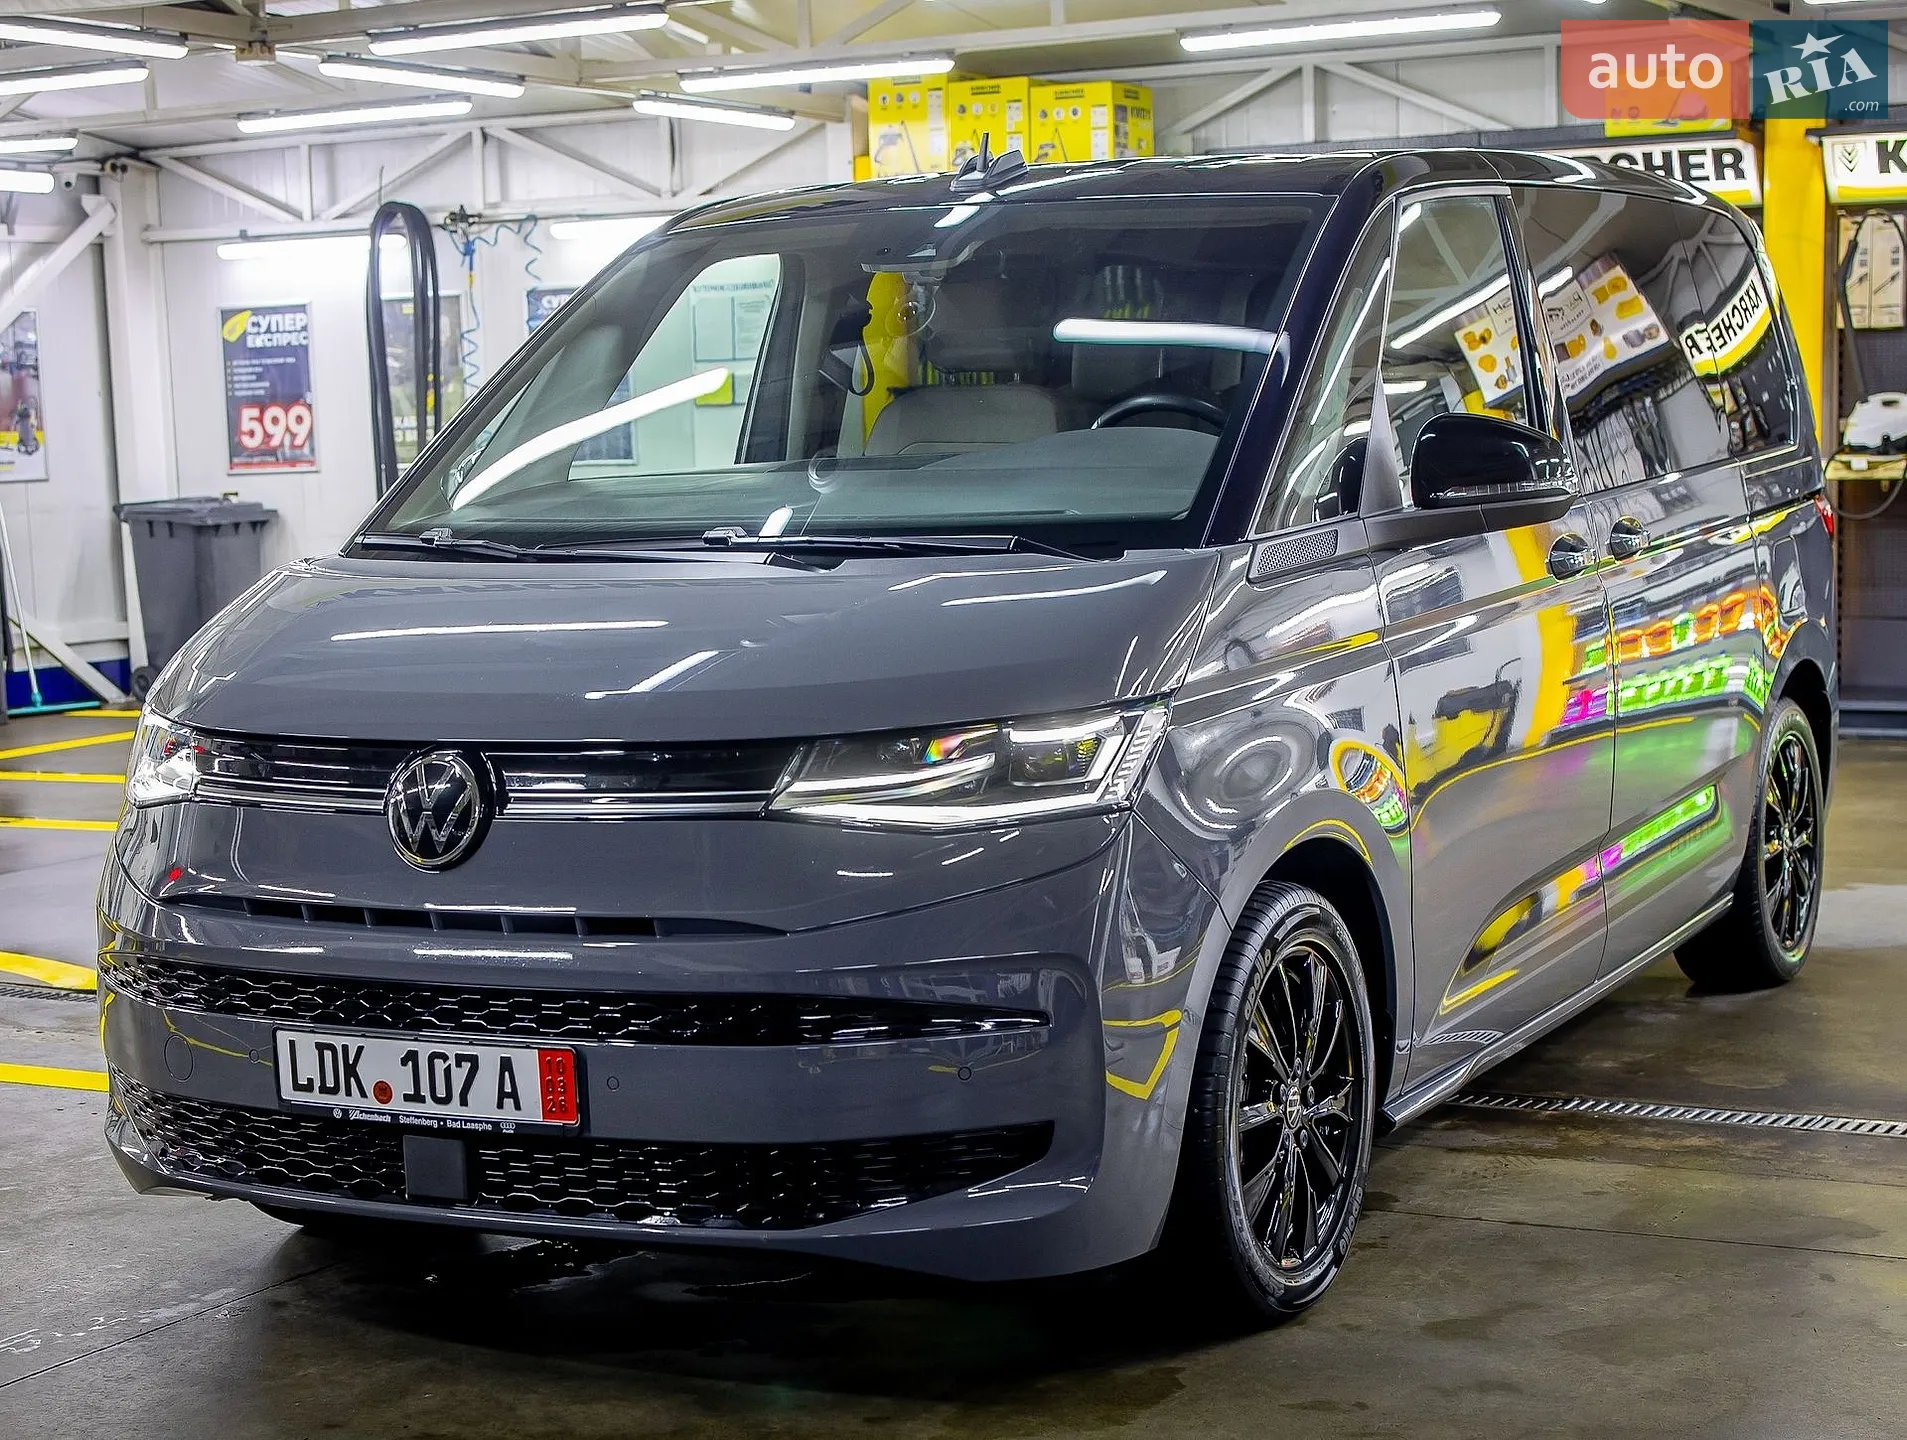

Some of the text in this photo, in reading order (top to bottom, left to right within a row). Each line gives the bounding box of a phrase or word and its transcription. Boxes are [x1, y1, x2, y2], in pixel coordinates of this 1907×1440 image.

[246, 331, 309, 348] ЕКСПРЕС
[247, 312, 308, 334] СУПЕР
[239, 403, 312, 449] 599
[1244, 949, 1271, 1020] apollo
[288, 1039, 522, 1111] LDK 107 A
[446, 1119, 461, 1129] Bad
[1340, 1185, 1363, 1256] apollo
